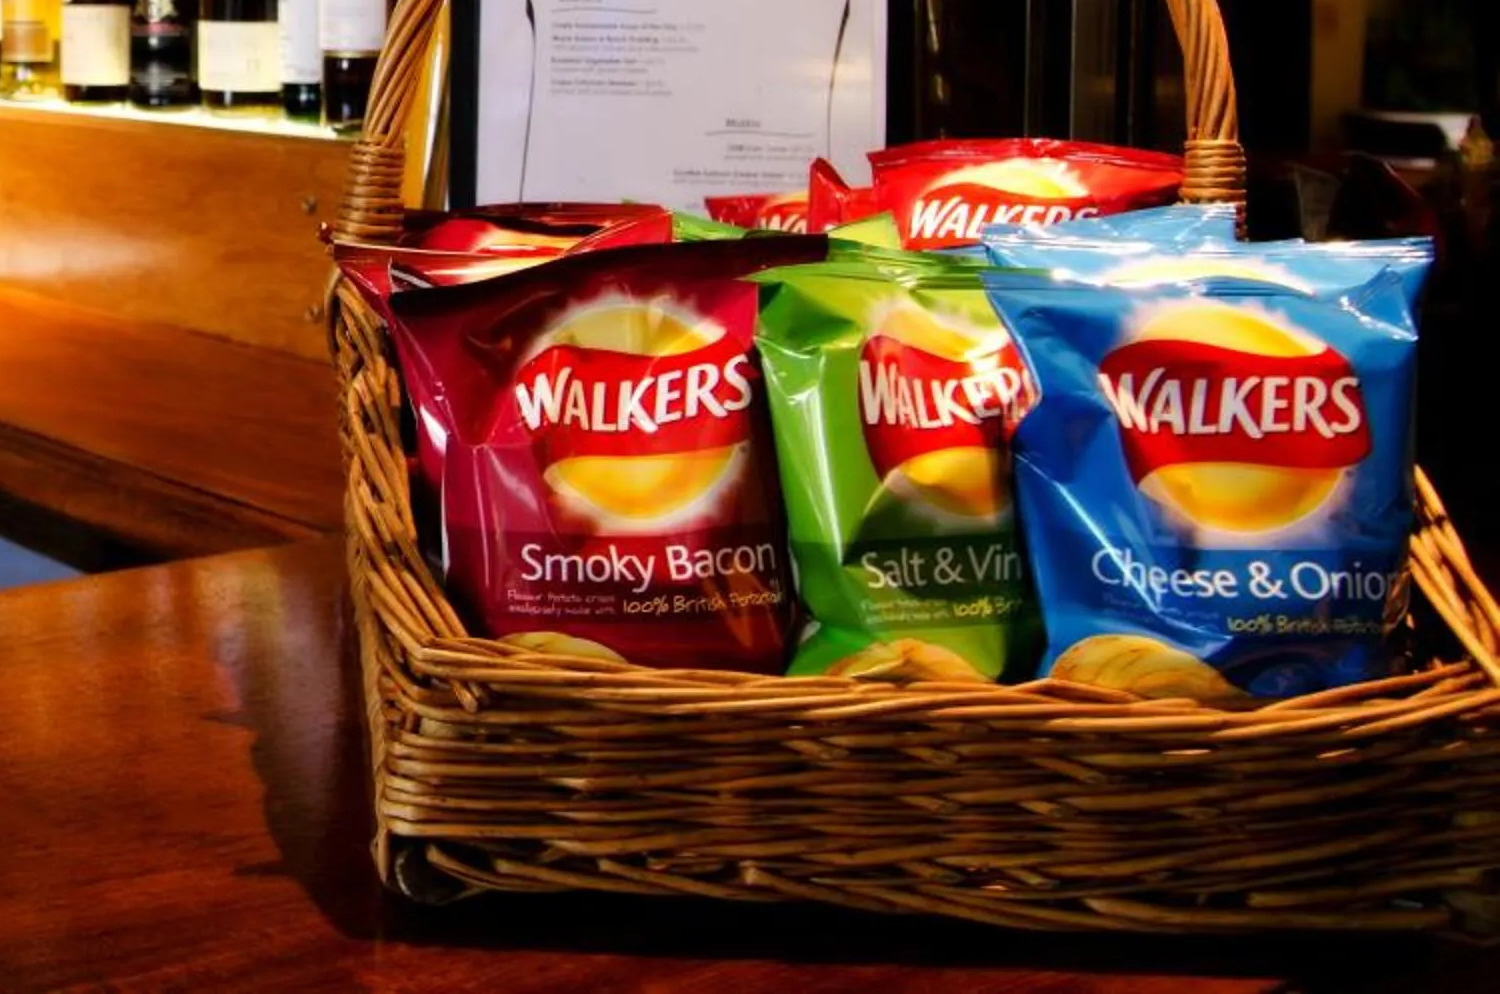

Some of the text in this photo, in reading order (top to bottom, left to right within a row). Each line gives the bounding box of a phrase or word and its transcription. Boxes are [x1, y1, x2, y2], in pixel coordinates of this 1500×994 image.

[515, 353, 753, 433] WALKERS
[1097, 367, 1362, 440] WALKERS
[520, 542, 777, 594] Smoky Bacon
[860, 547, 928, 588] Salt
[933, 547, 967, 585] &
[1091, 547, 1240, 600] Cheese
[1248, 561, 1288, 599] &
[623, 595, 669, 618] 100%
[673, 594, 727, 614] British
